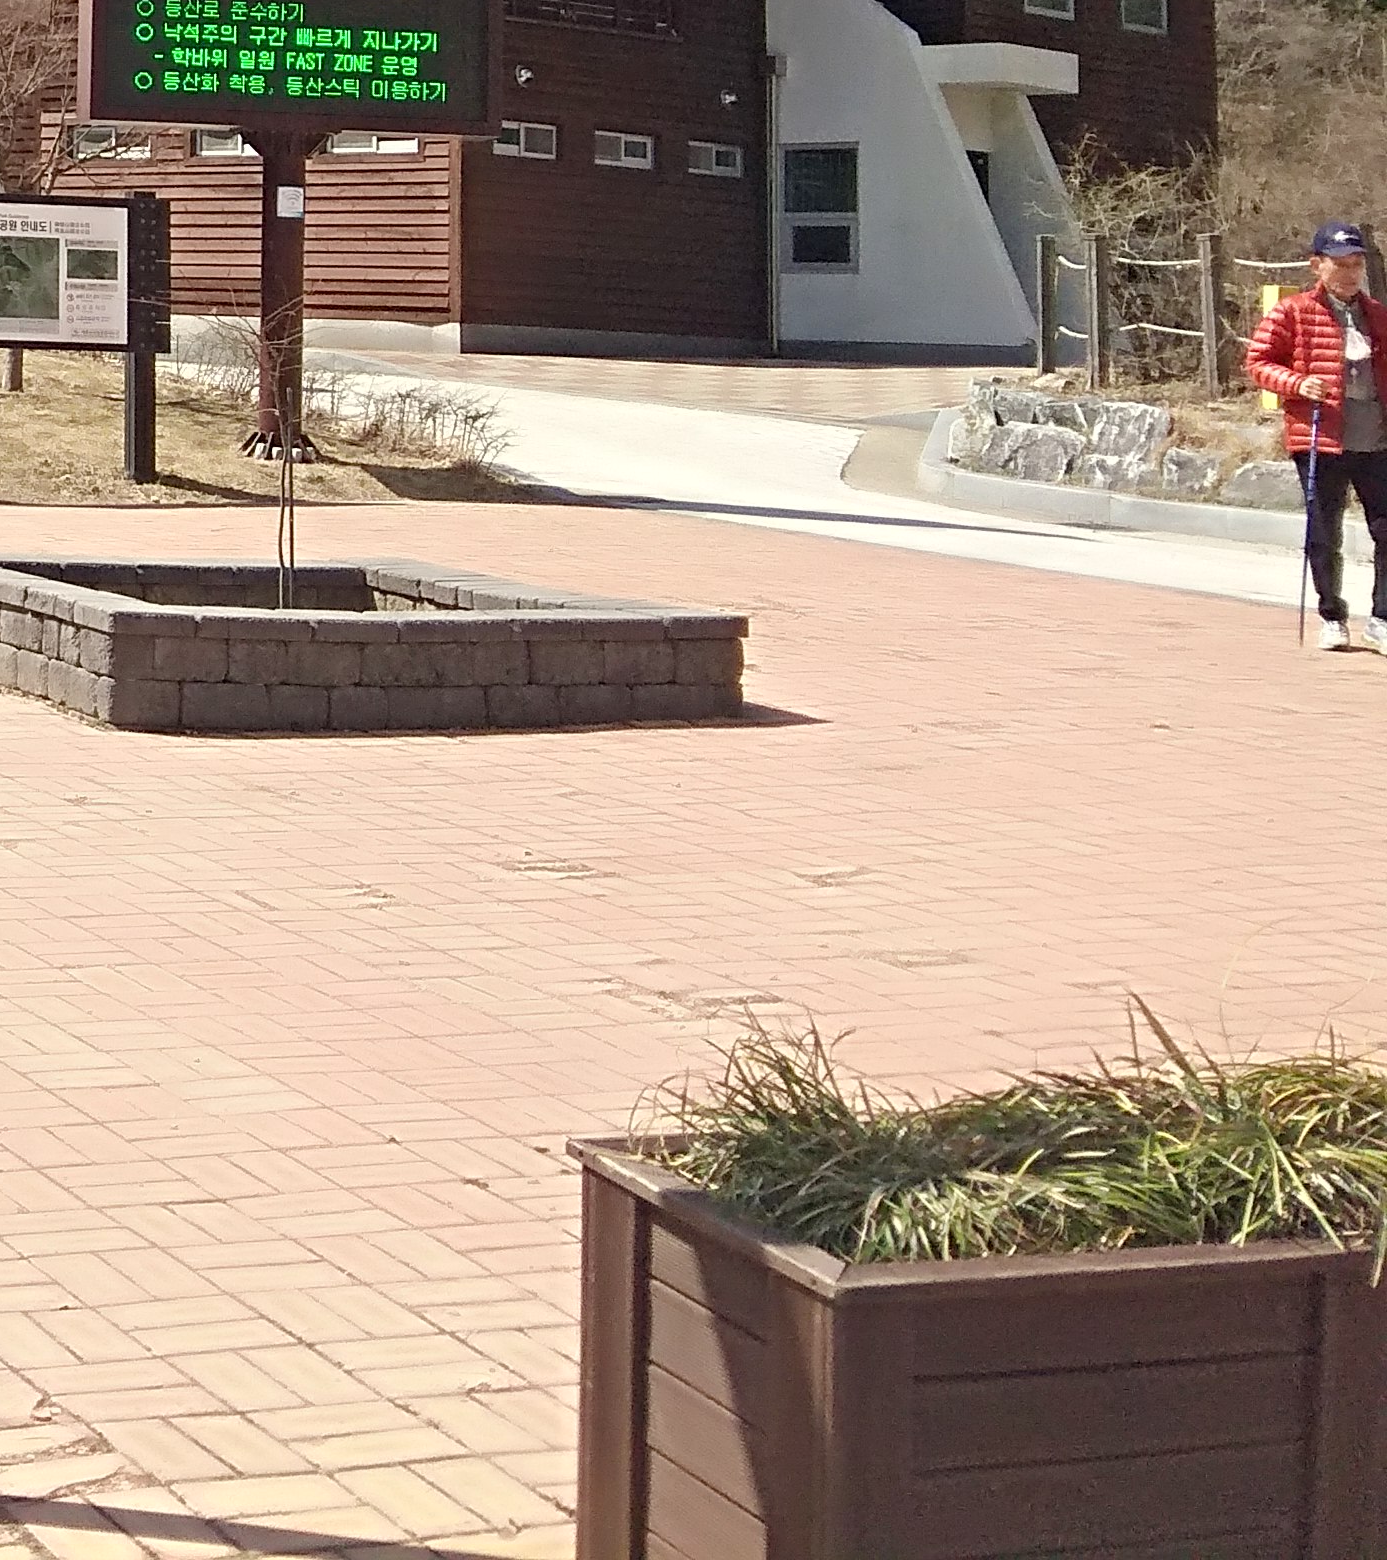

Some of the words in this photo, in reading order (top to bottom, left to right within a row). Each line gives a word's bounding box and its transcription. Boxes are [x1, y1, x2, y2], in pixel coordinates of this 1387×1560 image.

[164, 0, 220, 19] 등산로
[230, 0, 305, 23] 준수하기
[164, 23, 238, 44] 낙석주의
[249, 25, 288, 47] 구간
[296, 27, 352, 49] 빠르게
[362, 30, 438, 53] 지나가기
[171, 47, 228, 69] 학바위
[239, 49, 275, 71] 일원
[286, 51, 325, 72] FAST
[333, 53, 374, 73] ZONE
[380, 55, 418, 77] 운영
[163, 71, 220, 93] 등산화
[286, 76, 360, 100] 등산스틱
[371, 79, 446, 102] 이용하기
[21, 220, 48, 233] 안내도
